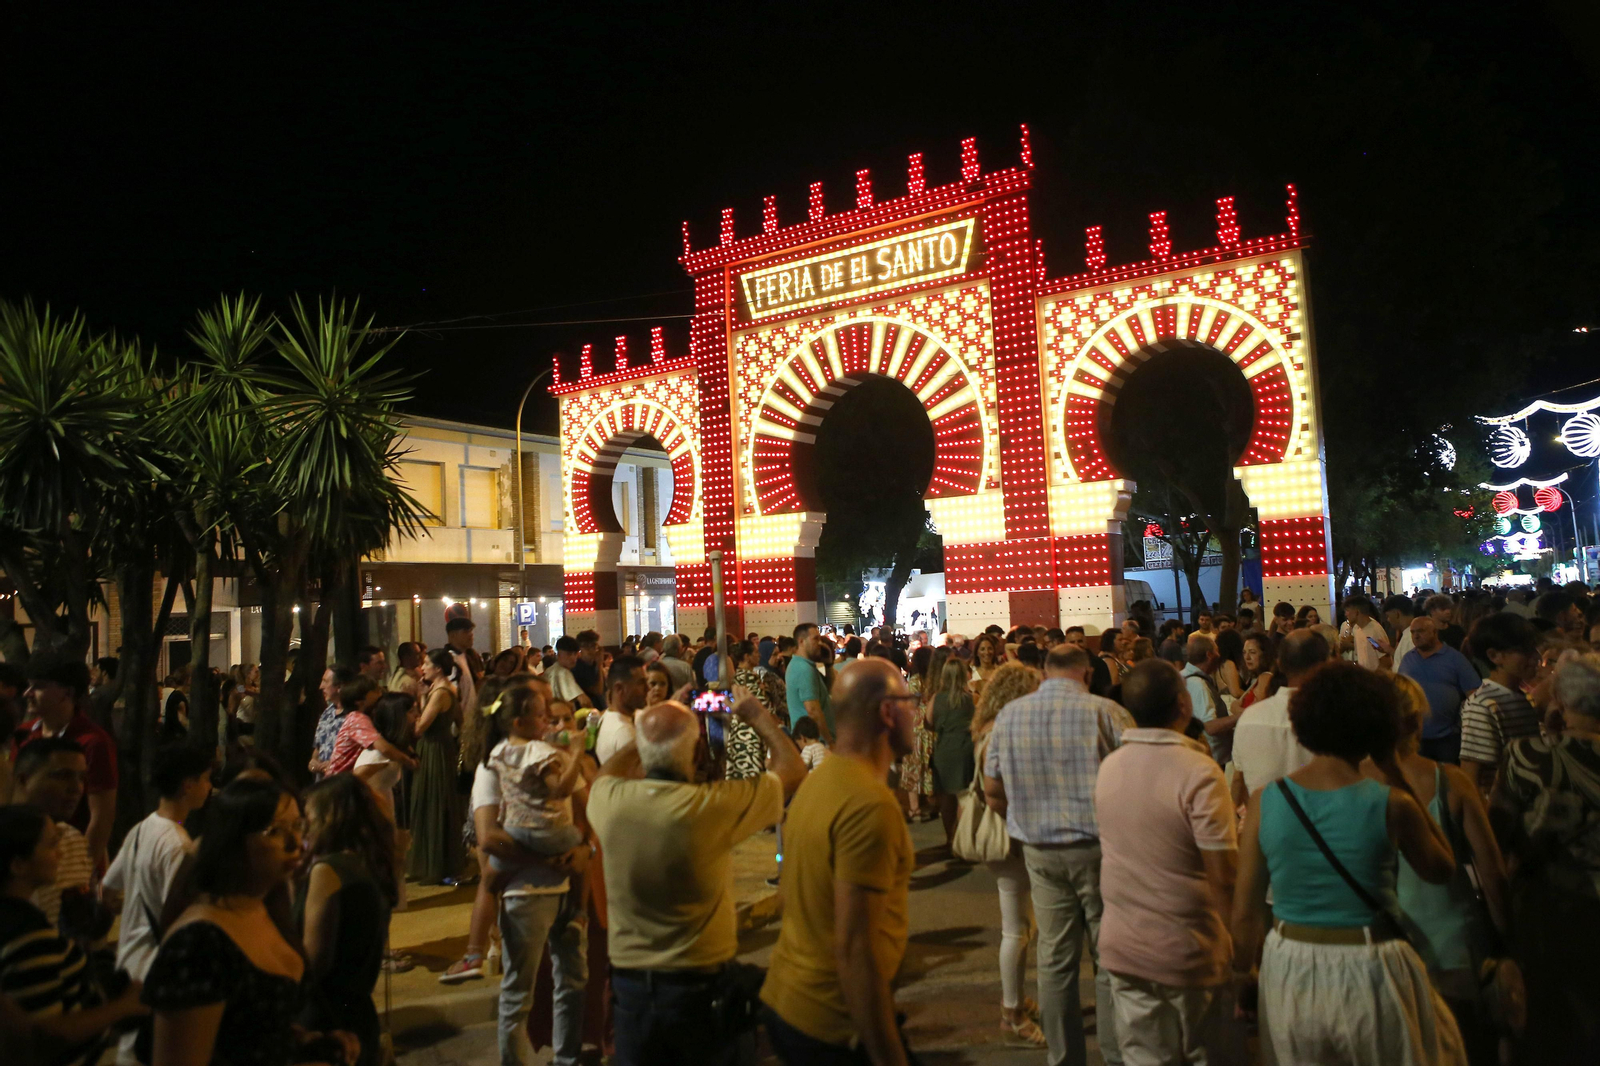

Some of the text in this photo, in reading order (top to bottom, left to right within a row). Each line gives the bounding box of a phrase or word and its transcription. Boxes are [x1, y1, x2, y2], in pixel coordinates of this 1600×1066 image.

[755, 232, 957, 308] FERIA DE EL SANTO
[520, 605, 532, 622] P
